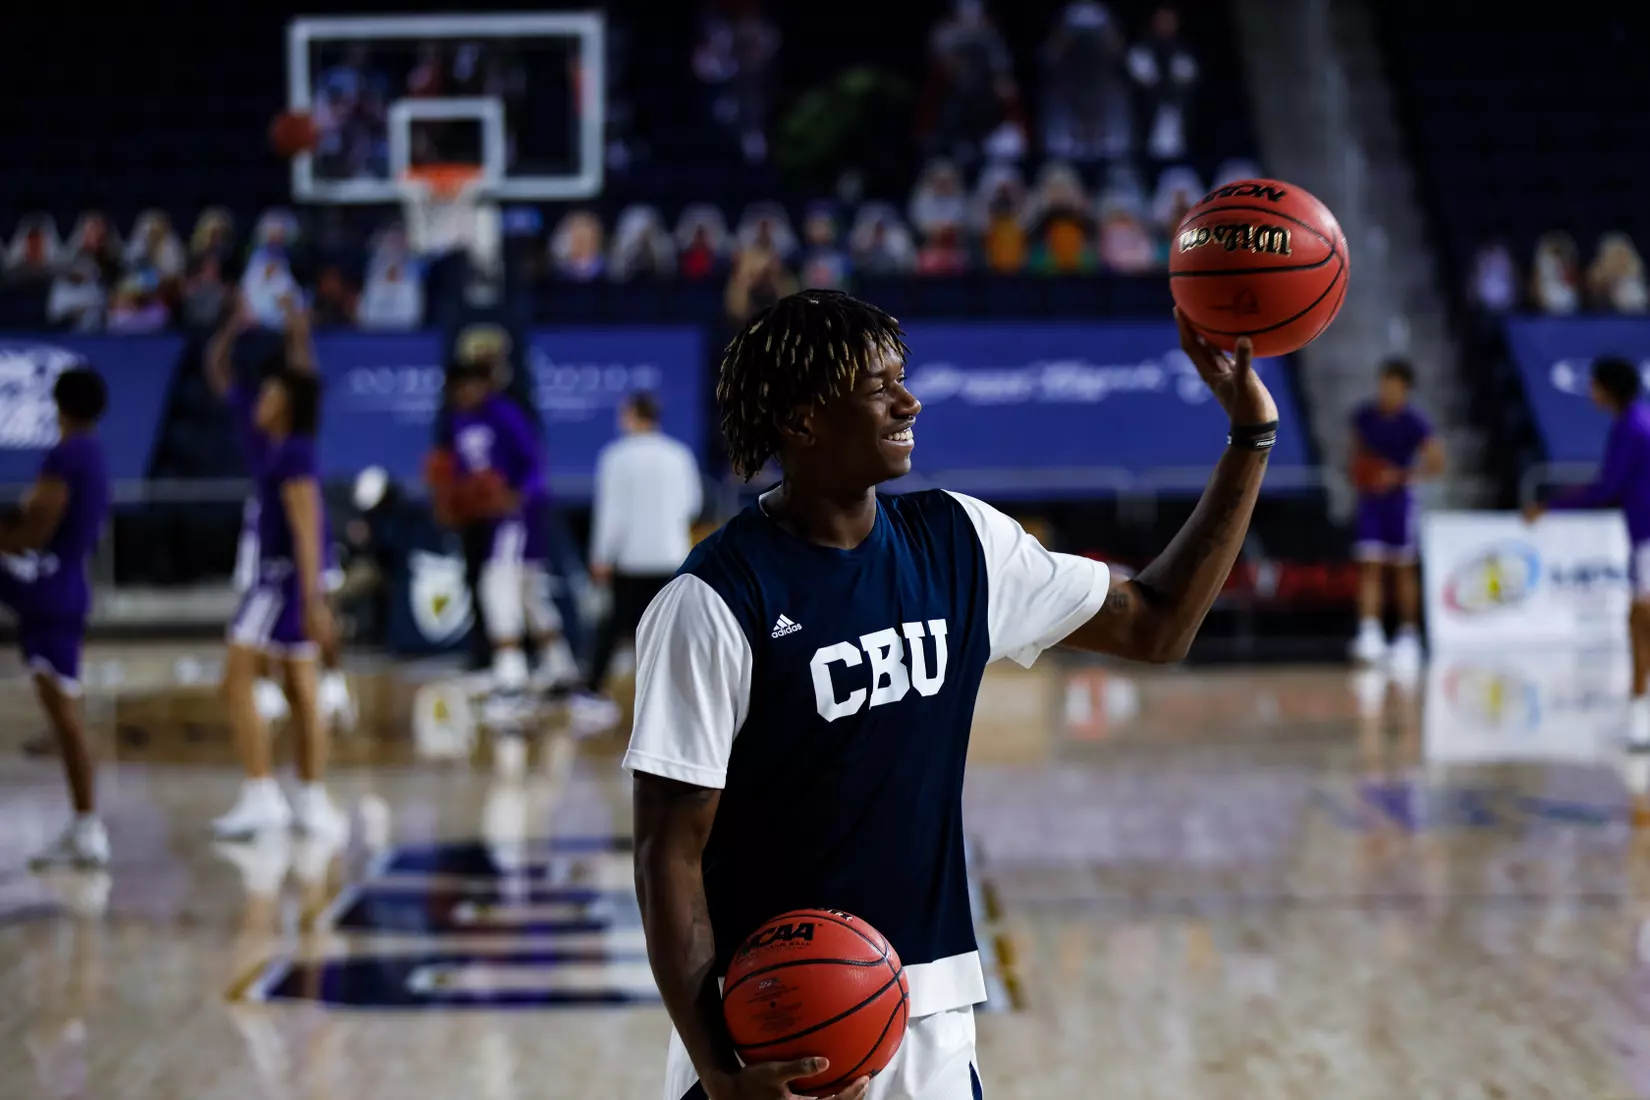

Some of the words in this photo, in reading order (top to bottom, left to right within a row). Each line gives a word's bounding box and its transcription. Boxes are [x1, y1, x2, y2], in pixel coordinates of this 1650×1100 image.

[1179, 223, 1292, 257] Wilson
[771, 623, 803, 639] adidas
[809, 618, 949, 723] CBU
